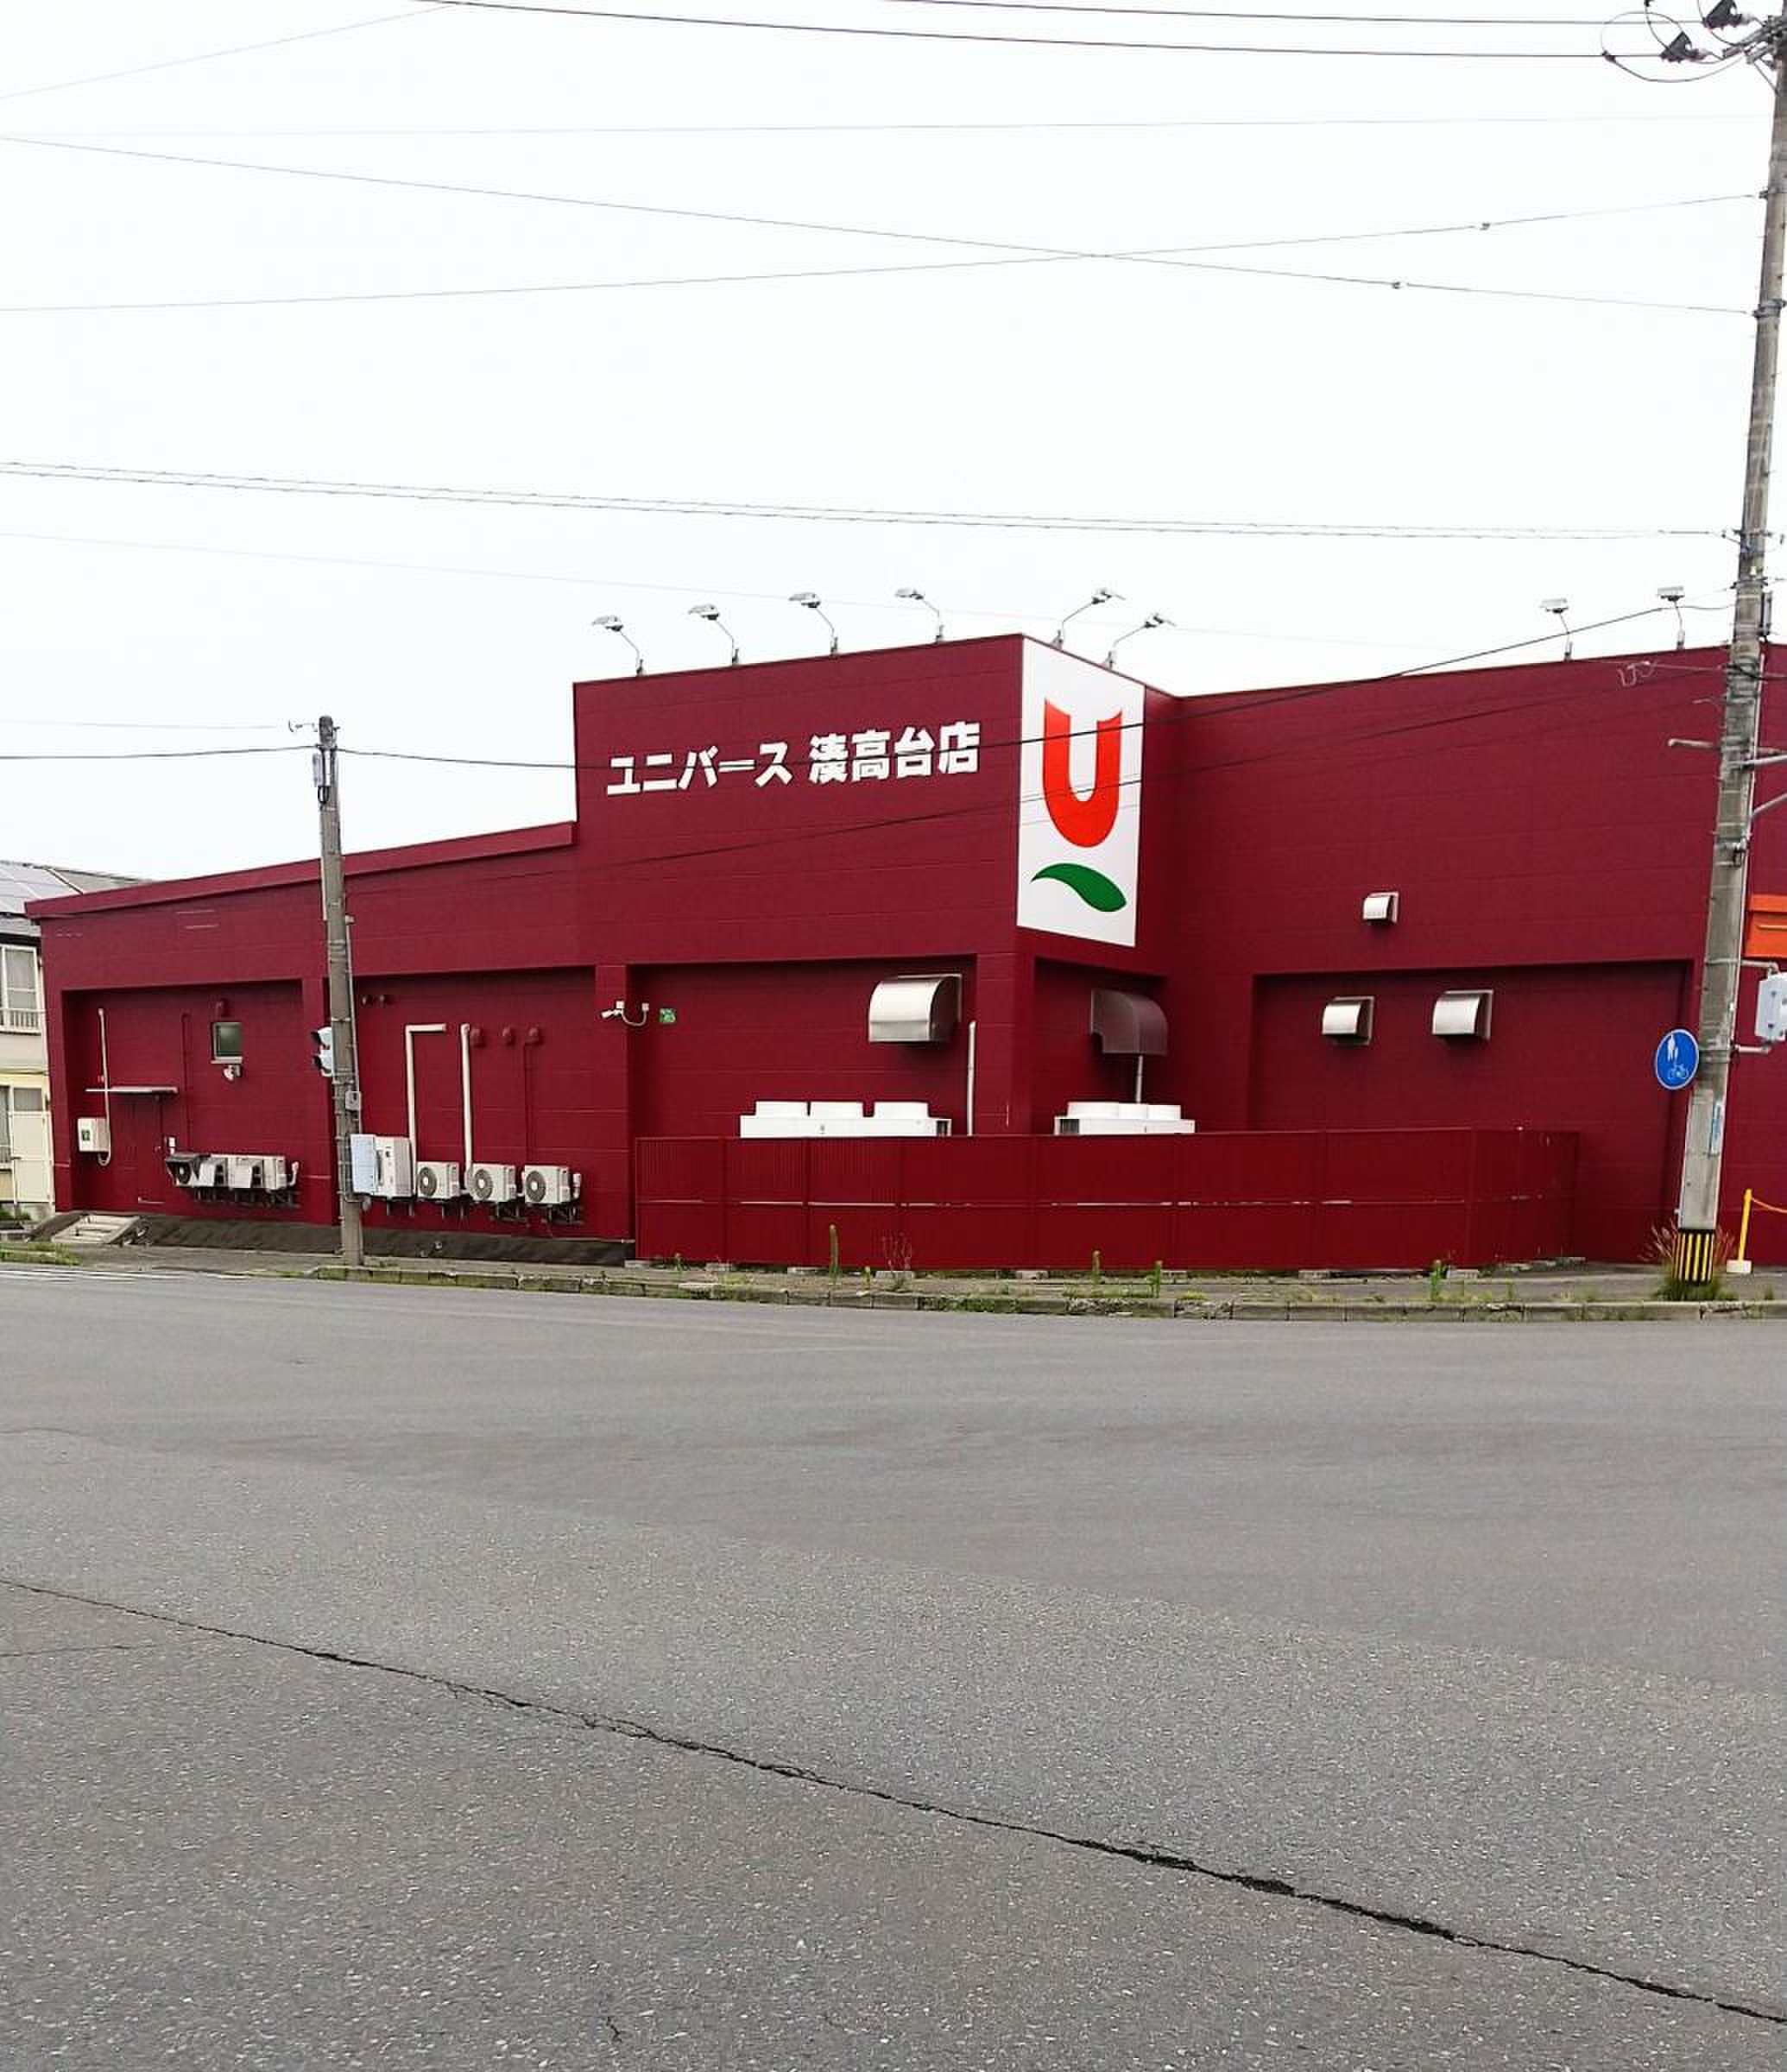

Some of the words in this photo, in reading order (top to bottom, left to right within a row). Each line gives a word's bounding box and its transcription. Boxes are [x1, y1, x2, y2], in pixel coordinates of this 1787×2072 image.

[607, 742, 792, 795] ユニバース
[808, 721, 980, 784] 湊高台店
[1042, 698, 1122, 848] U
